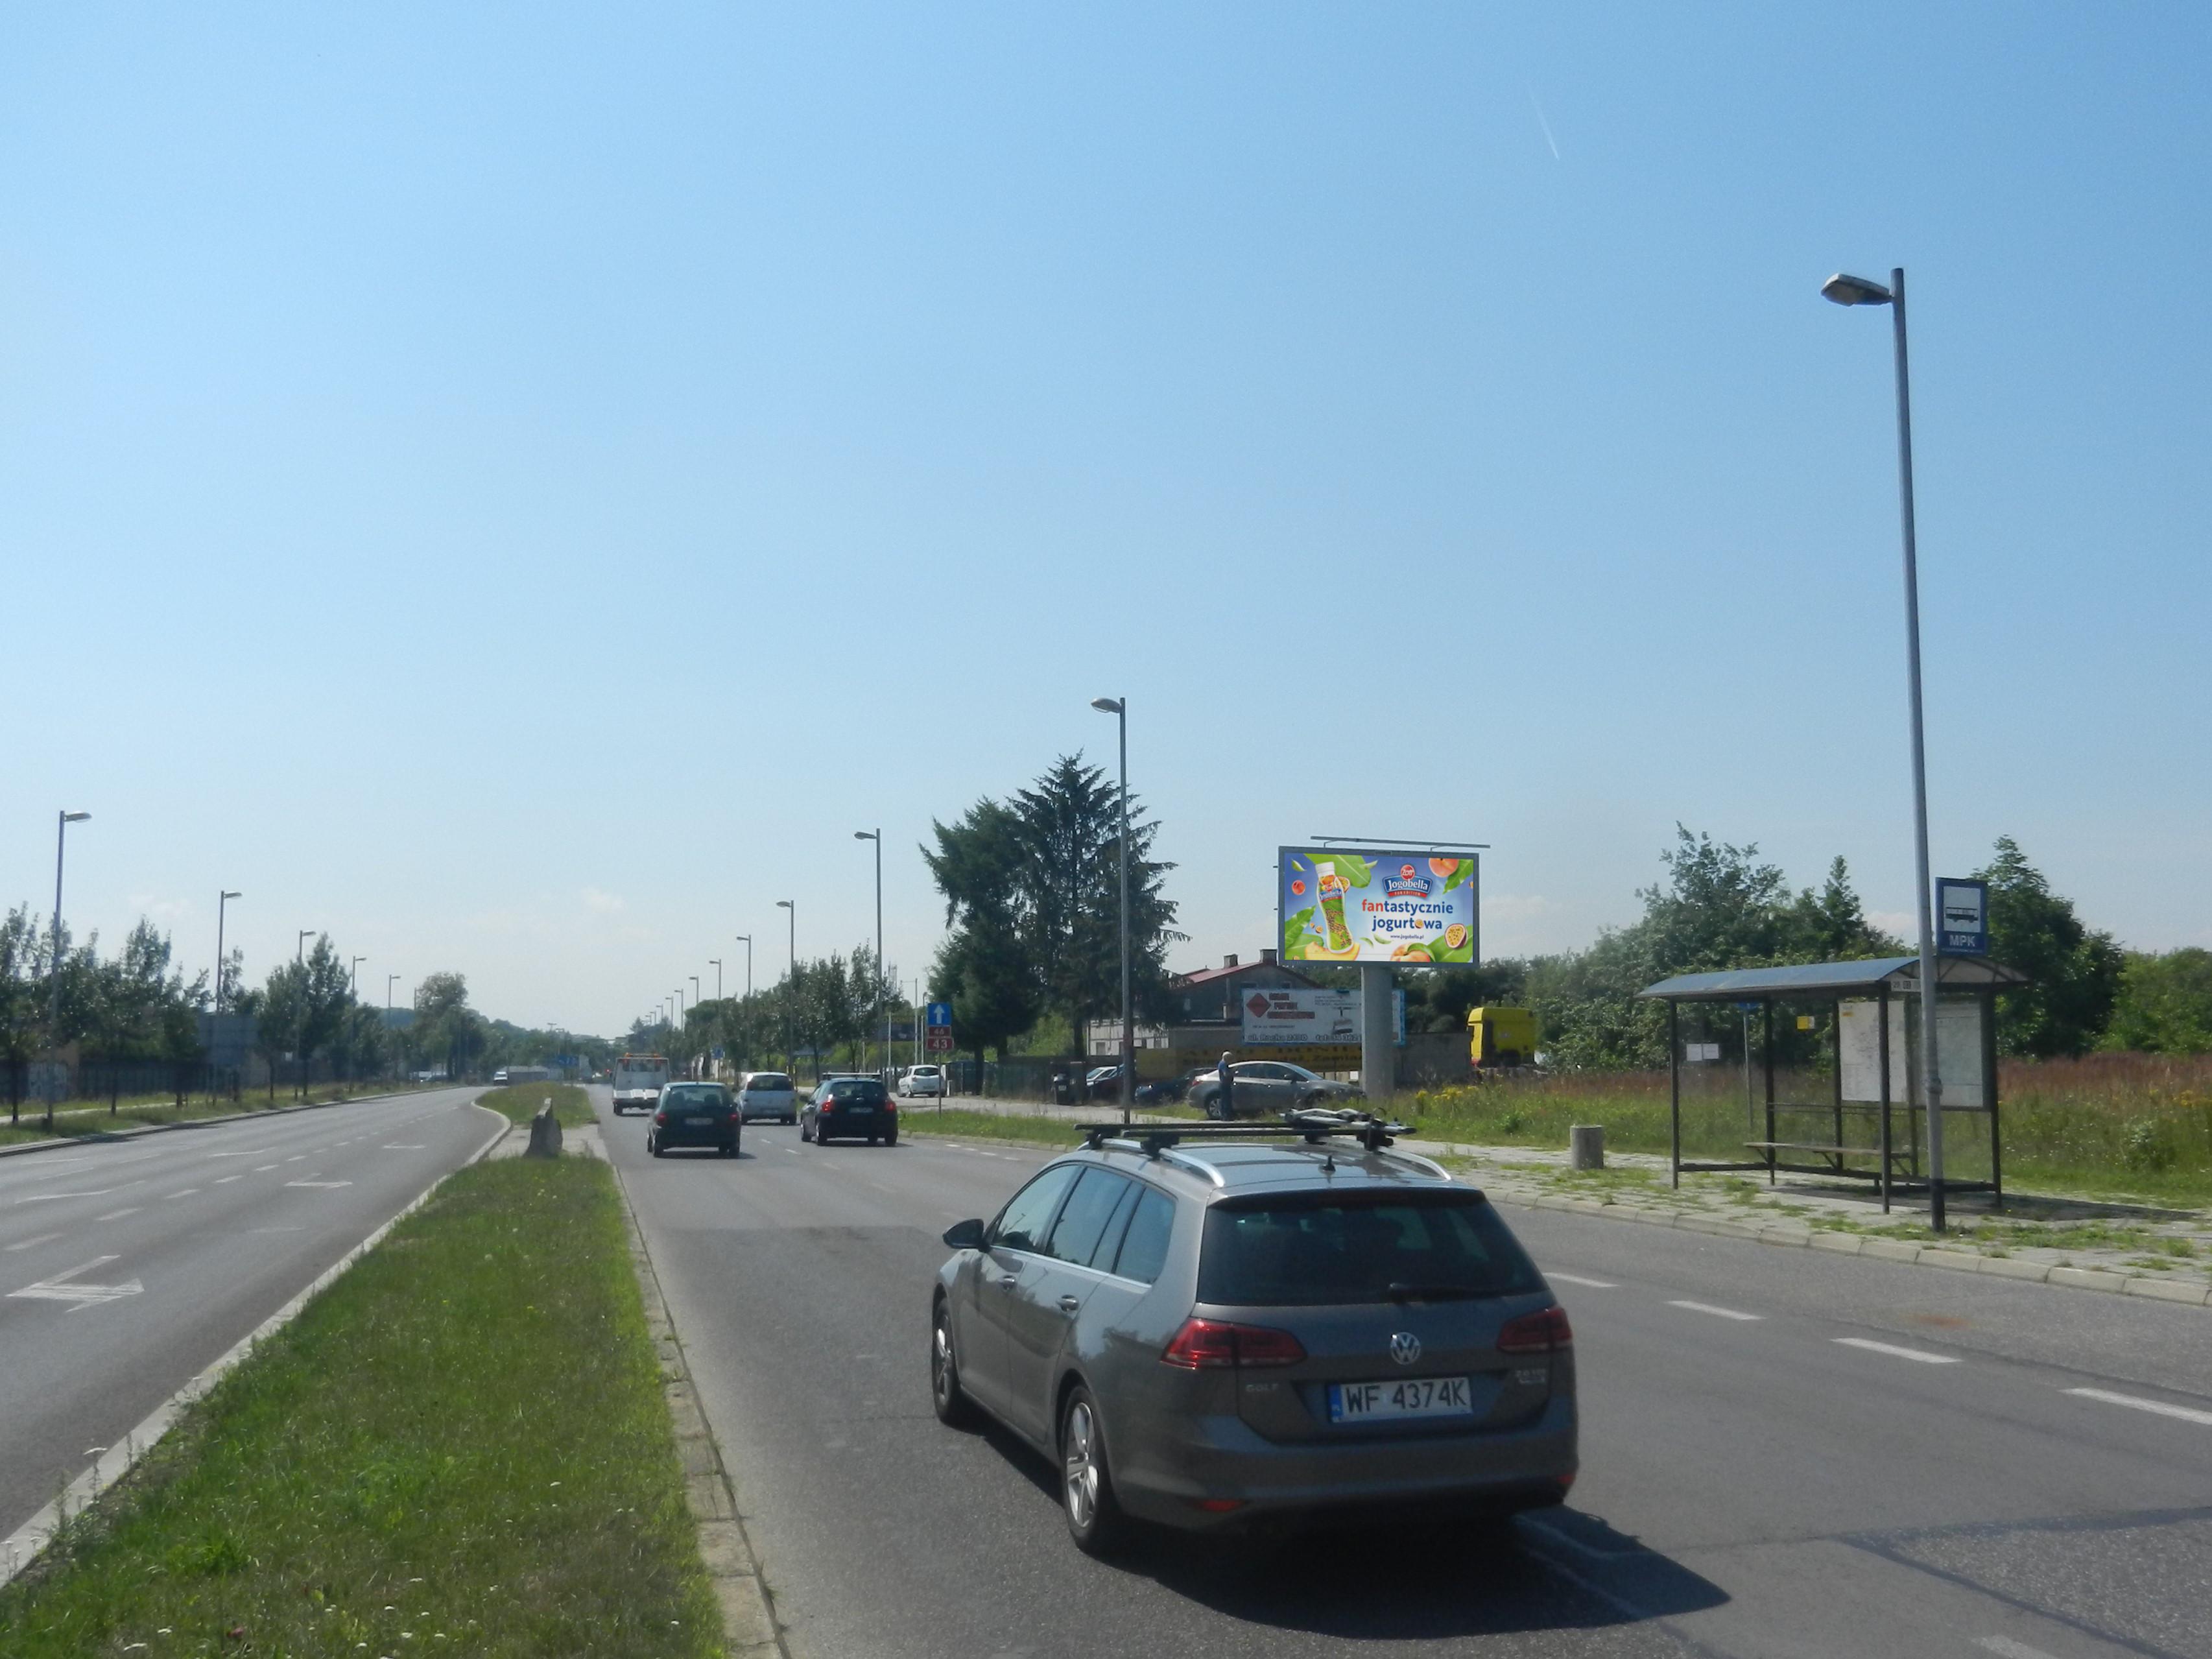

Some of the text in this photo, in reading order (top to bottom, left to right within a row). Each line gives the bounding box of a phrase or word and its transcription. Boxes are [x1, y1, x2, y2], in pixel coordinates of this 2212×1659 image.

[1388, 878, 1429, 891] Jogobella
[1362, 899, 1453, 916] fantastycznie
[1372, 916, 1442, 932] jogurtowa
[1949, 935, 1975, 947] MPK
[933, 1039, 947, 1049] 43
[1346, 1380, 1466, 1413] WF 4374K
